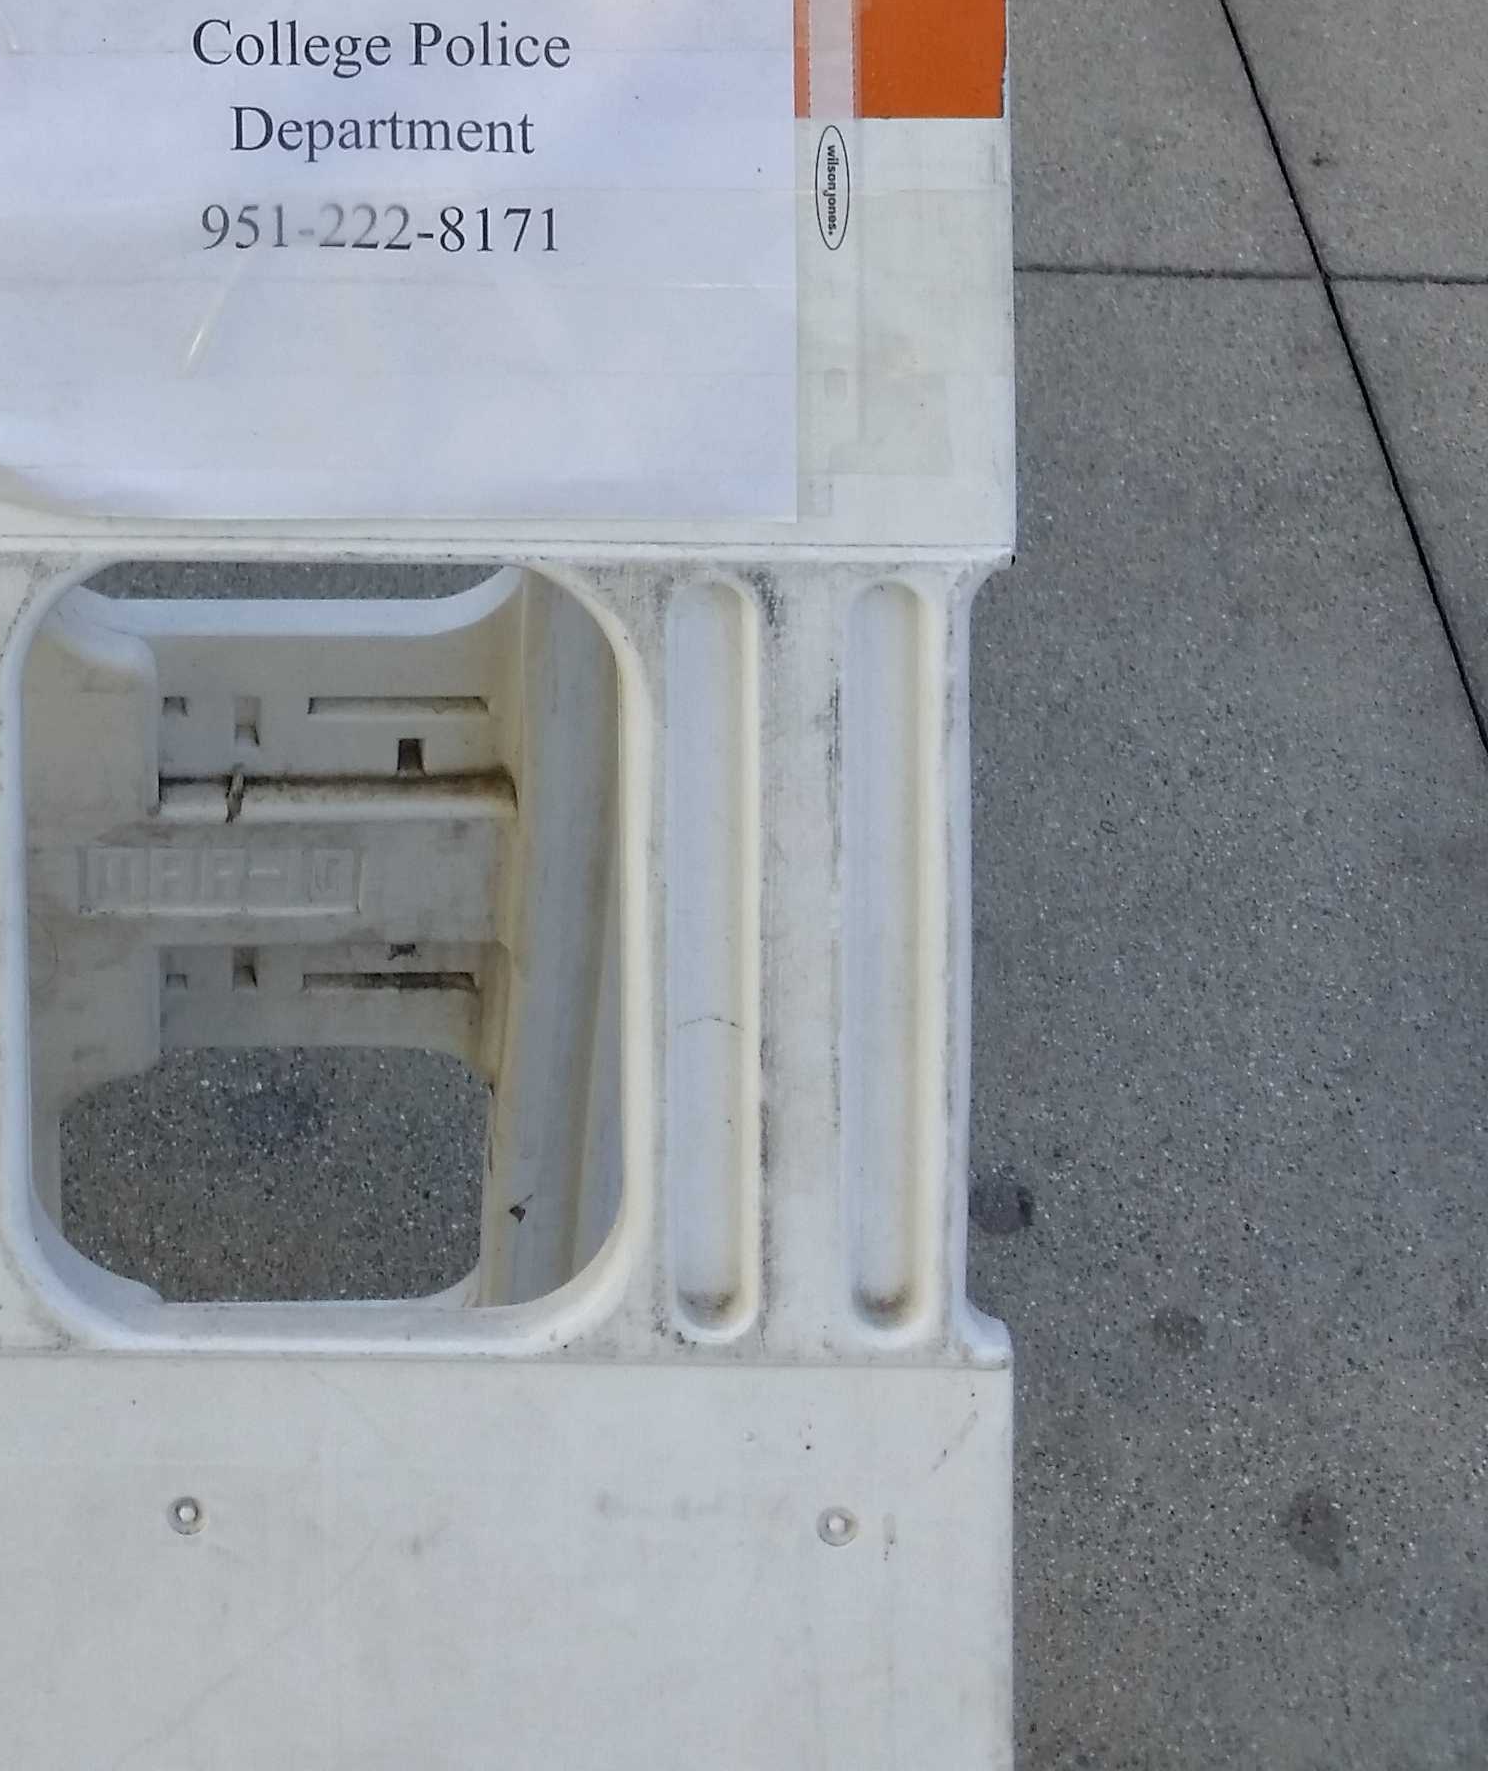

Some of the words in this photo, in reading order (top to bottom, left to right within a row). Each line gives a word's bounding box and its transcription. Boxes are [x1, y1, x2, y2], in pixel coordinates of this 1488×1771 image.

[193, 19, 391, 78] College
[409, 21, 570, 68] Police
[230, 106, 535, 163] Department
[826, 145, 839, 190] wilson
[202, 204, 558, 252] 951-222-8171
